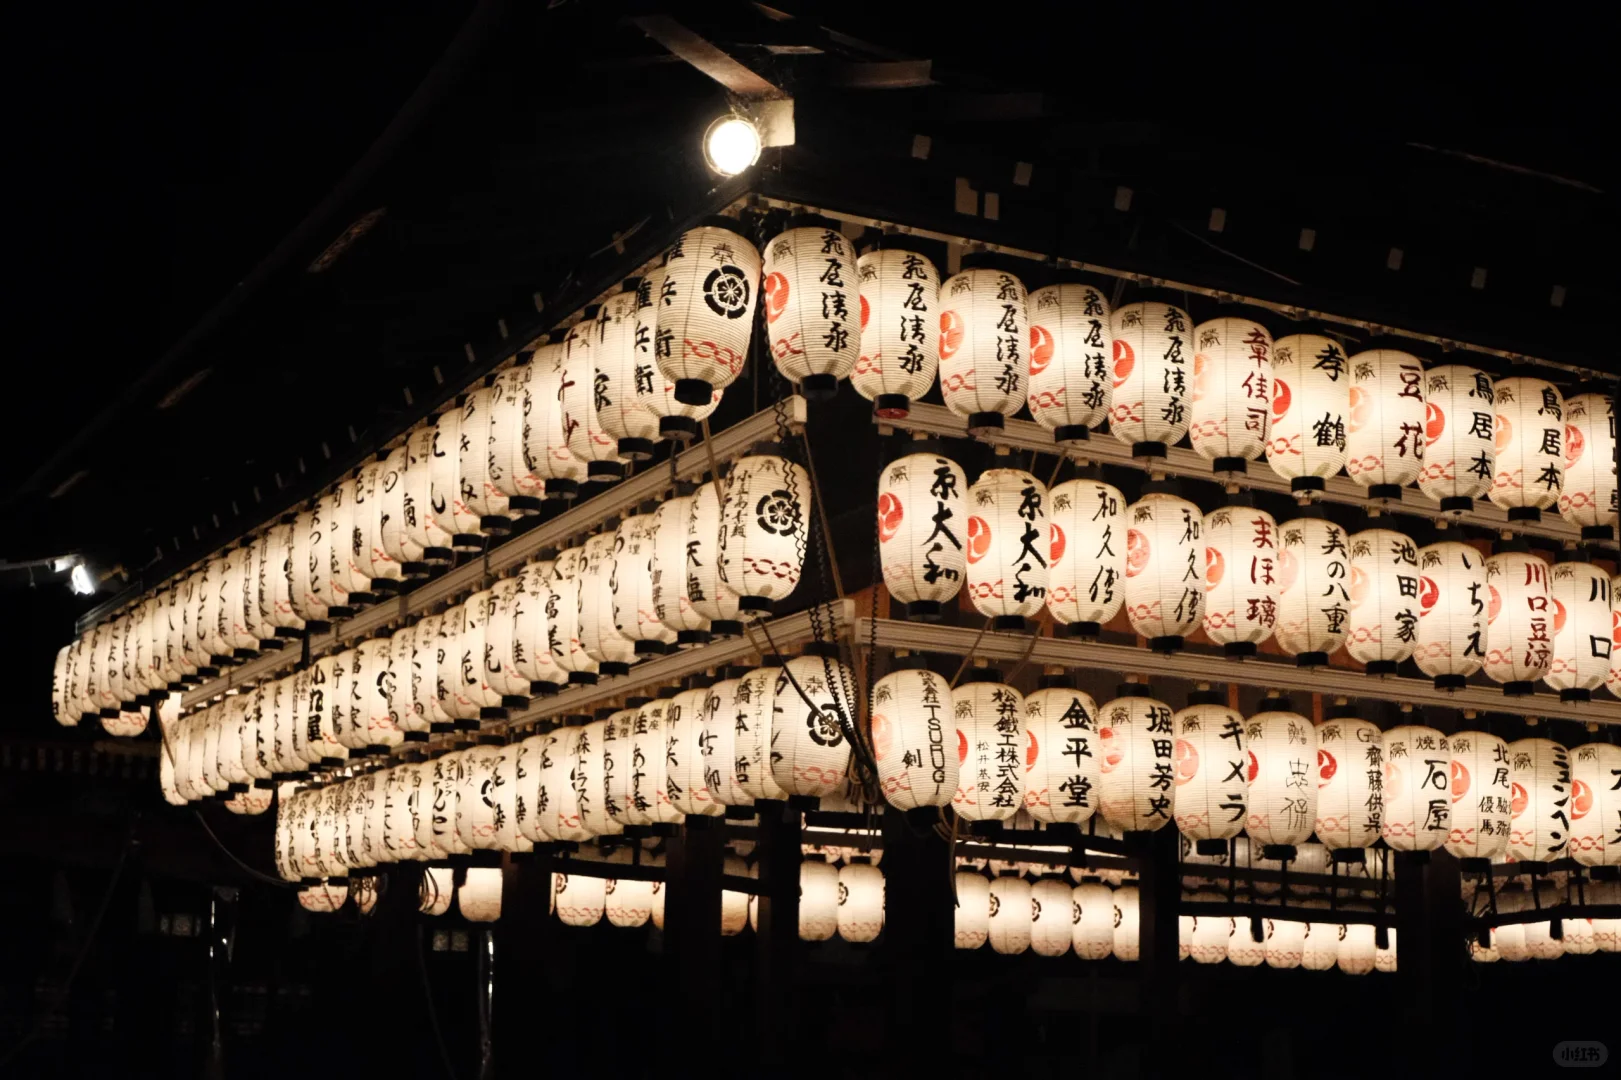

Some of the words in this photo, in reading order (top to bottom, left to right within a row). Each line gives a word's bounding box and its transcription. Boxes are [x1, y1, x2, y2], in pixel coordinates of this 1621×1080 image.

[1242, 328, 1269, 442] 章佳司
[1312, 344, 1346, 453] 孝鶴
[1394, 364, 1423, 460] 豆花
[1466, 372, 1494, 480] 鳥居本
[1535, 386, 1562, 491] 鳥居本
[1321, 526, 1350, 634] 美の八重
[1391, 539, 1418, 643] 池田家
[1462, 552, 1486, 656] いちえ
[1525, 562, 1550, 669] 川口豆涼
[1589, 576, 1612, 660] 川口
[1058, 697, 1092, 808] 金平堂
[1143, 705, 1174, 819] 堀田芳史
[1219, 715, 1246, 823] キメラ
[1421, 759, 1449, 831] 石屋
[1492, 744, 1510, 788] 北尾
[1548, 746, 1570, 852] ミュンヘン
